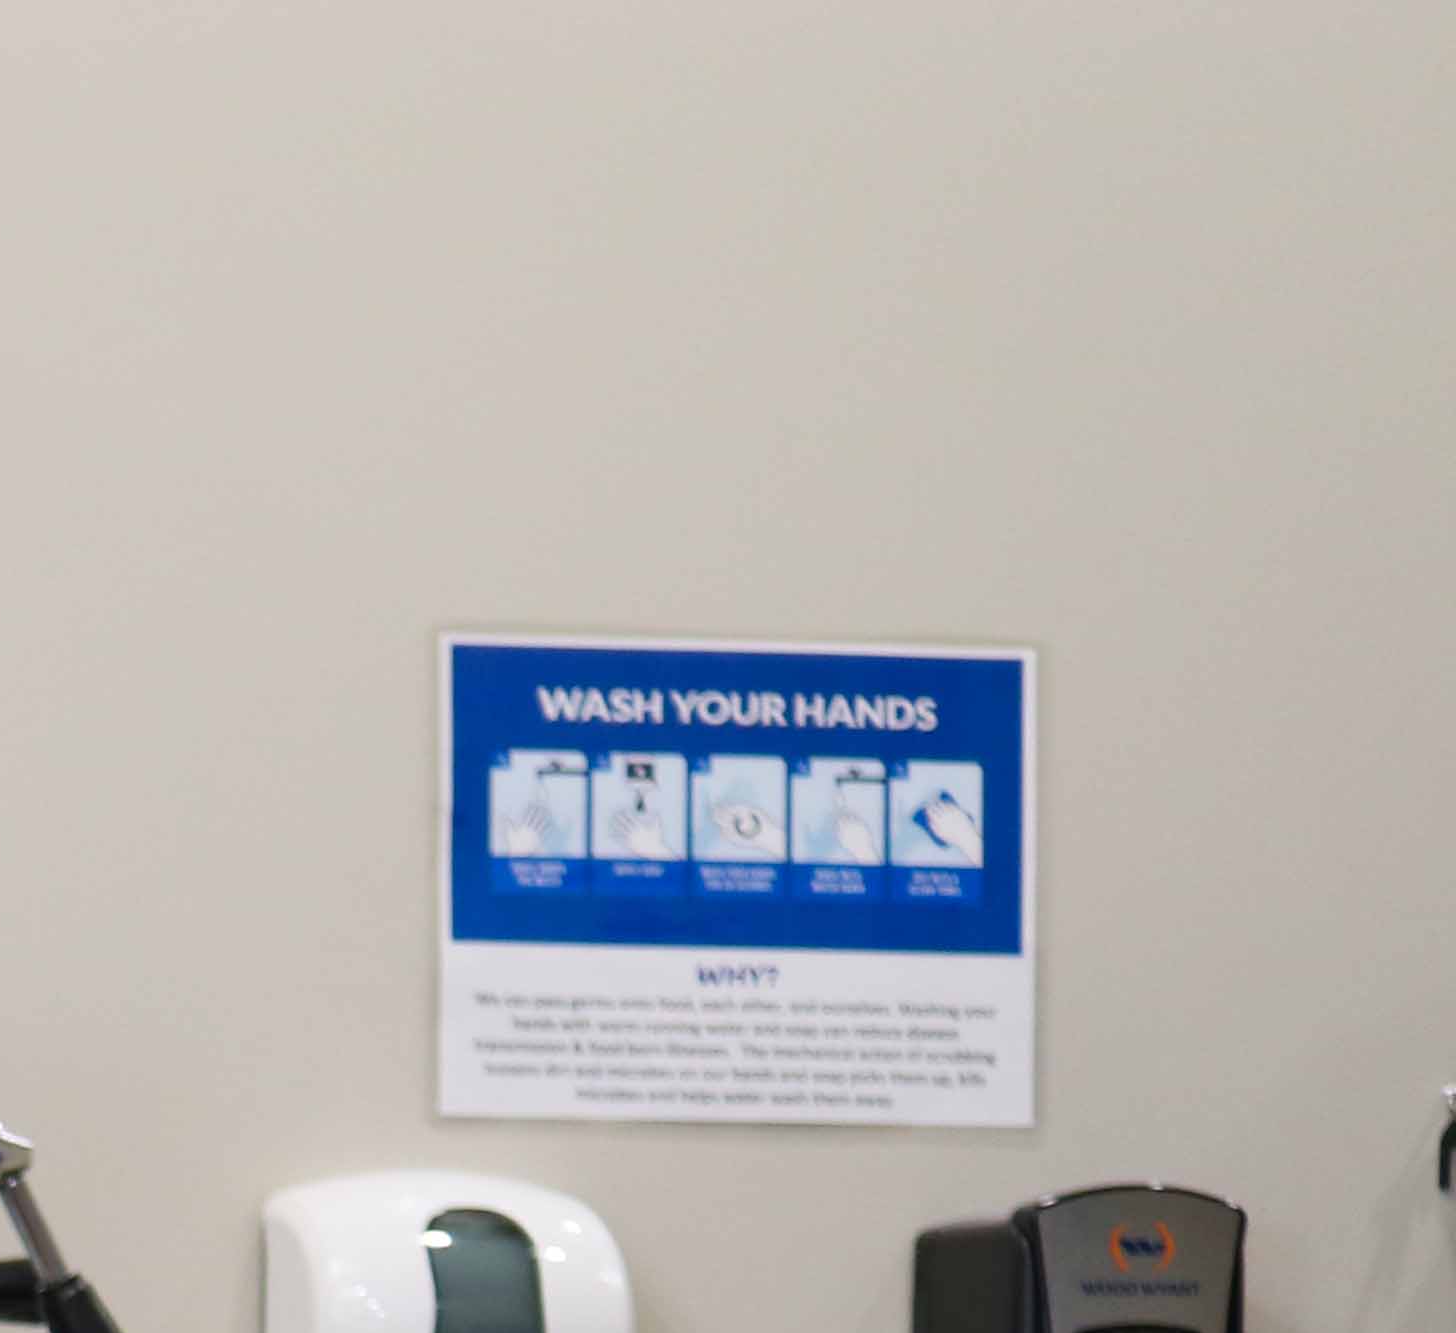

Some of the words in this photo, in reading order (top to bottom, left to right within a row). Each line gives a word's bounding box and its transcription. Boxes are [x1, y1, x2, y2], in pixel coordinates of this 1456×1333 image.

[536, 685, 664, 725] WASH
[670, 688, 789, 728] YOUR
[792, 692, 940, 733] HANDS
[696, 966, 779, 988] WHY?
